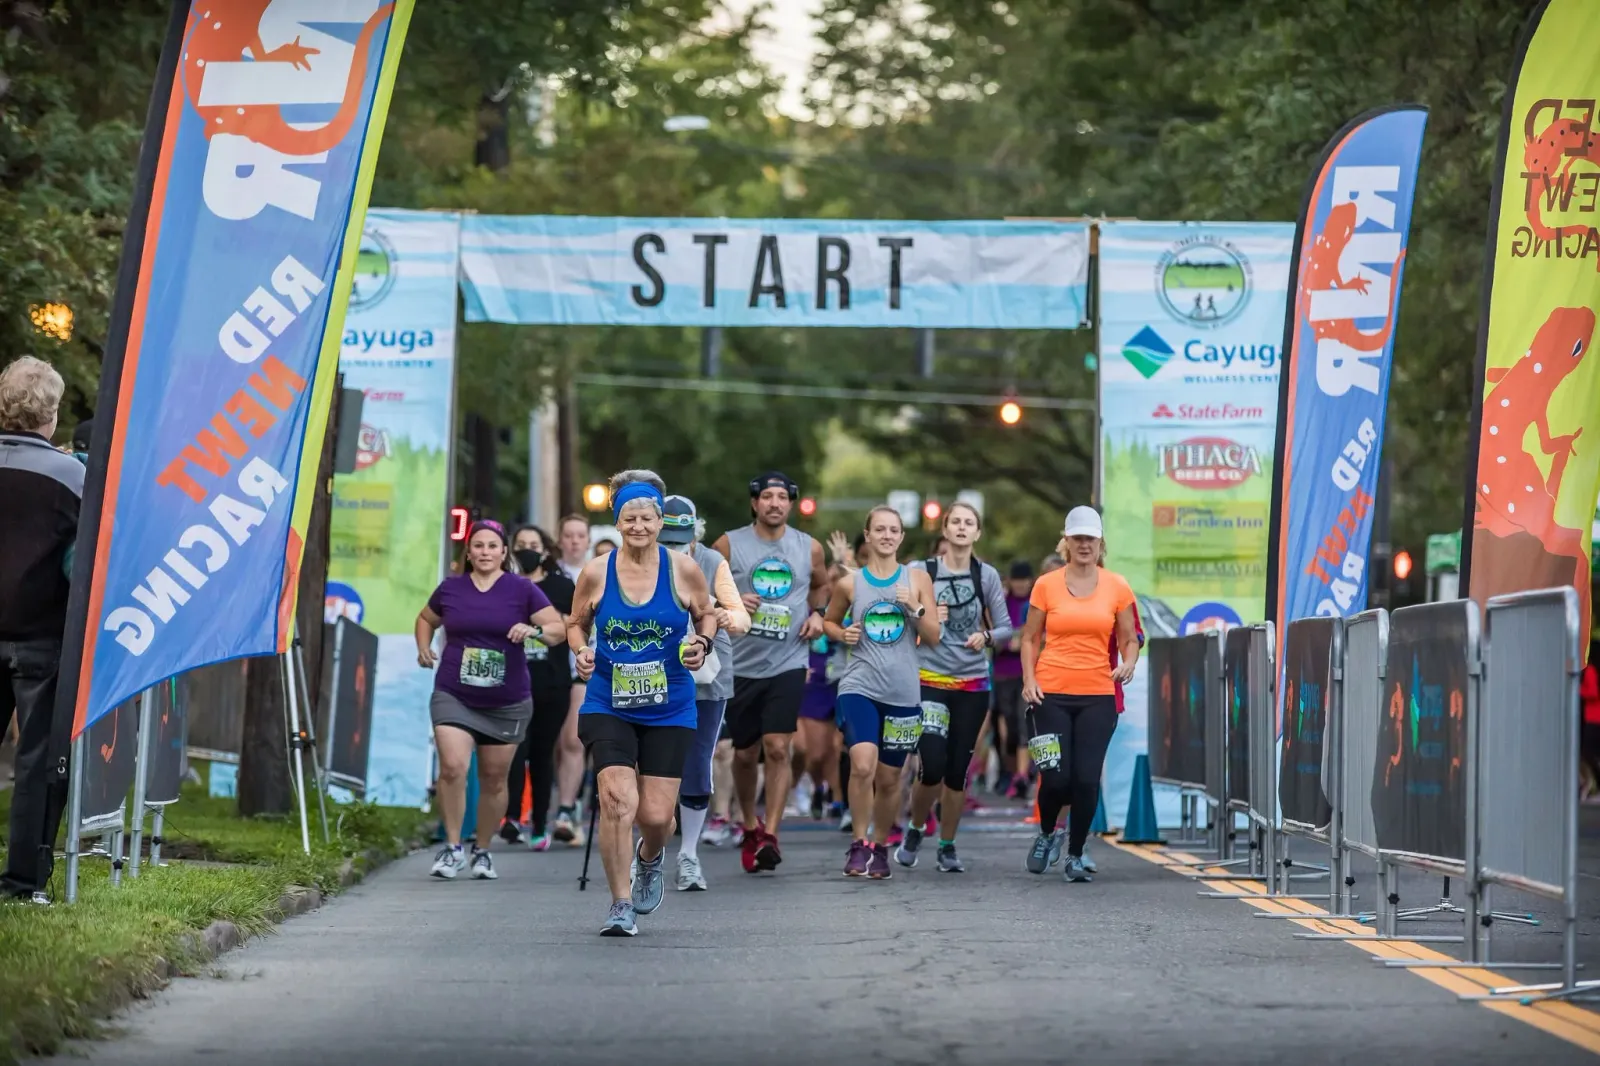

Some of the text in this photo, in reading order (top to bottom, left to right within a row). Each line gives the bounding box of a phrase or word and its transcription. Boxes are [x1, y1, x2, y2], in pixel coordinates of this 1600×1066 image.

[631, 233, 914, 310] START
[342, 329, 434, 353] ayuga
[1184, 339, 1282, 368] Cayug
[1184, 375, 1279, 384] WELLNESS CENT
[1156, 444, 1263, 477] ITHACA
[1174, 468, 1215, 480] BEER
[760, 616, 780, 630] 475
[629, 679, 651, 695] 316
[896, 729, 915, 743] 296
